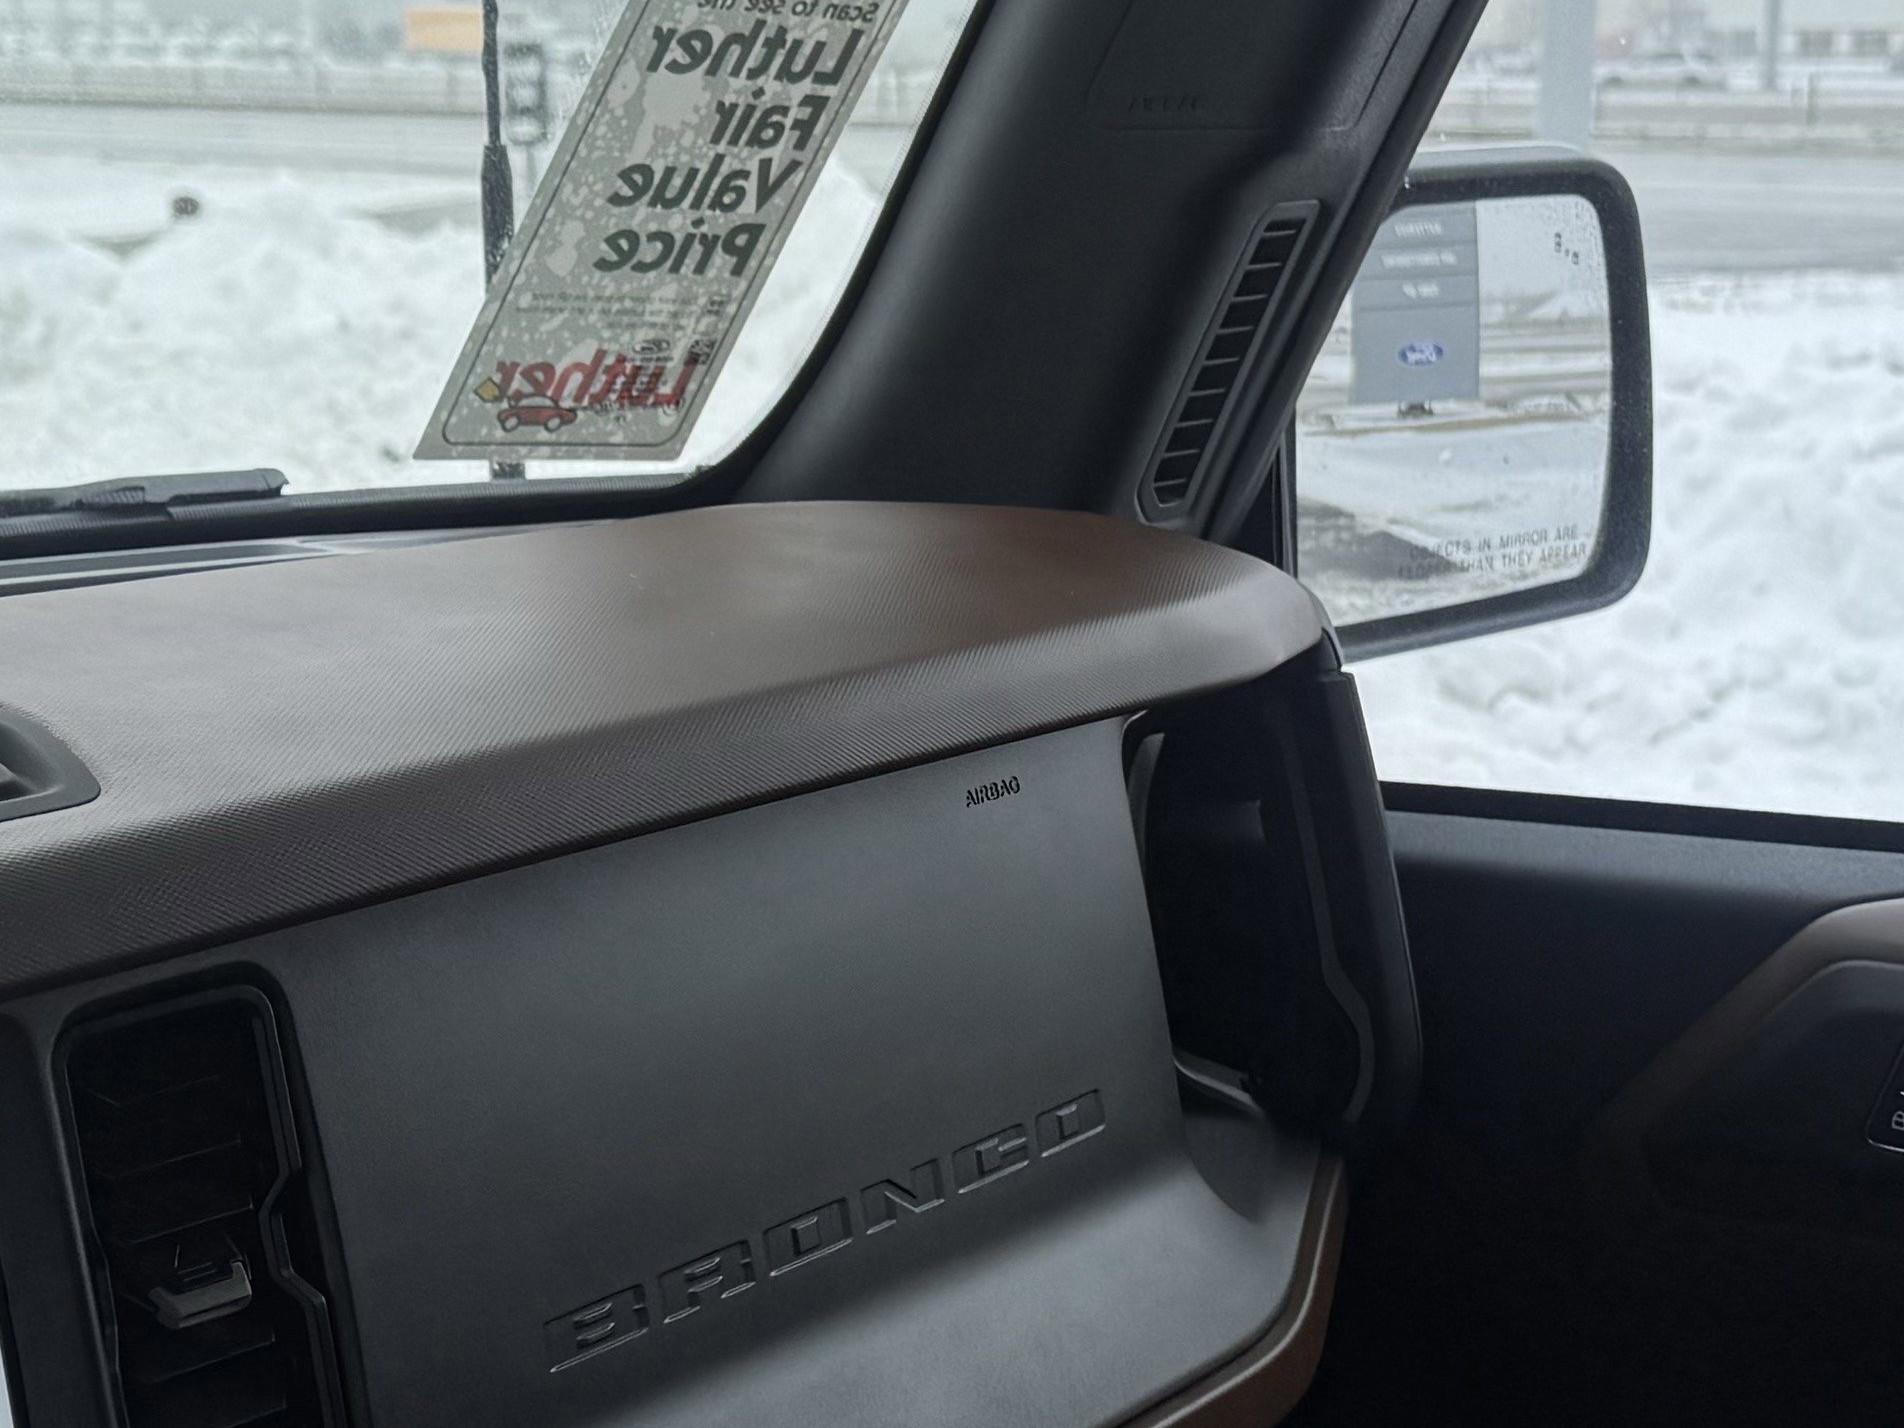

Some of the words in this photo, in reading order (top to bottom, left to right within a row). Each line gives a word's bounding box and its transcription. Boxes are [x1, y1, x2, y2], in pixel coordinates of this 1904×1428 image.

[1499, 529, 1548, 548] MIRROR
[1555, 524, 1578, 540] ARE
[542, 1088, 1106, 1372] BRONCO
